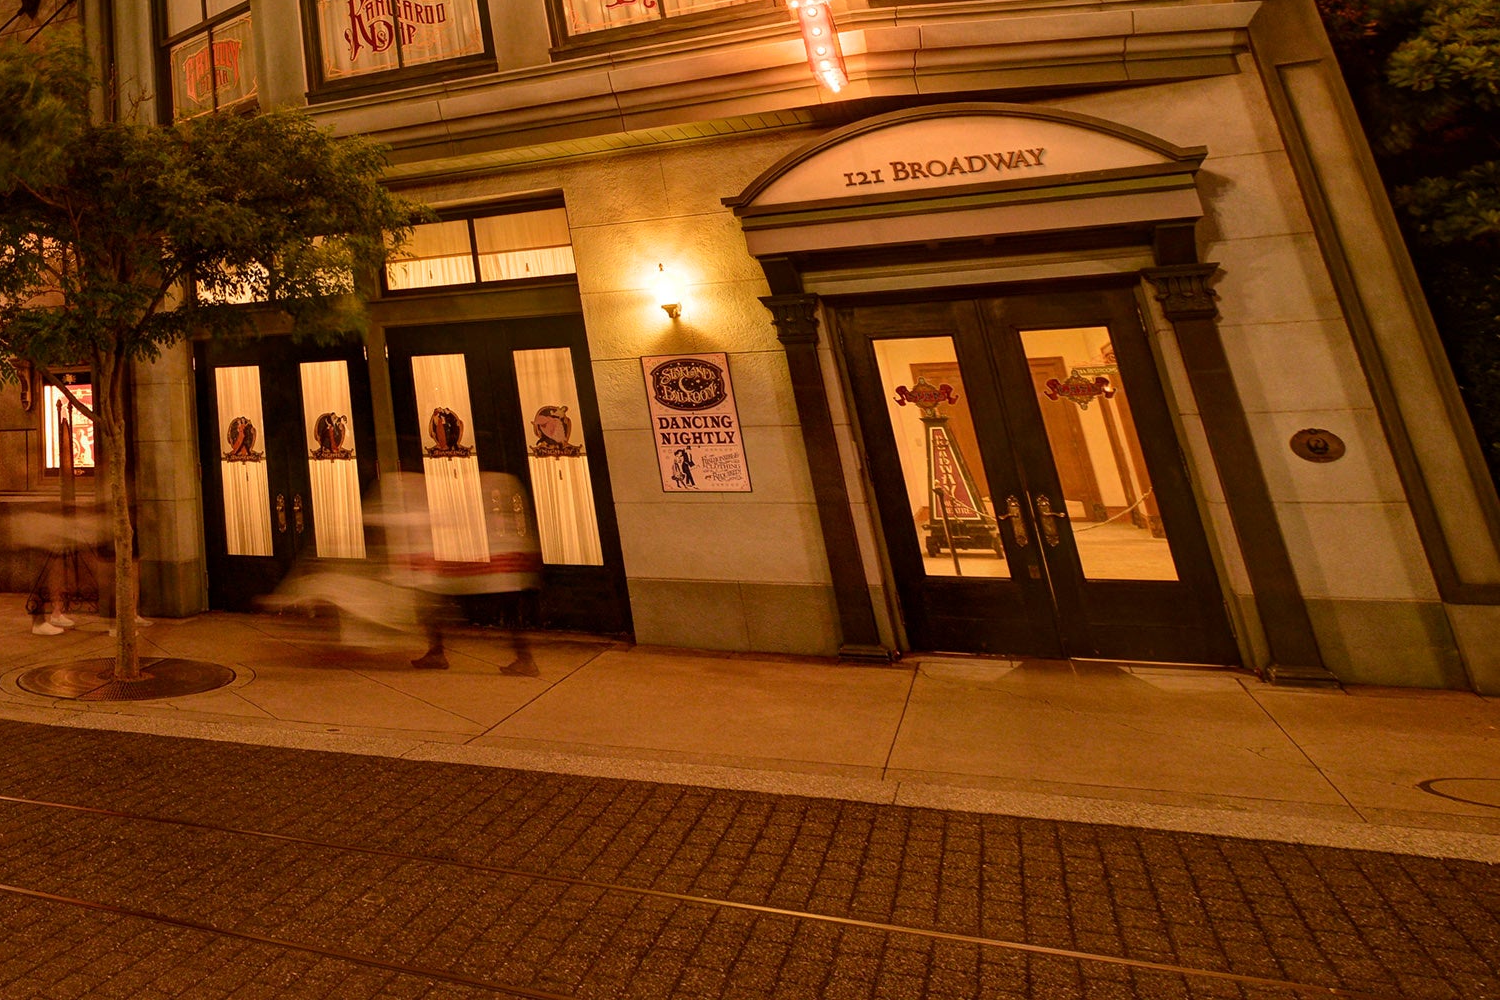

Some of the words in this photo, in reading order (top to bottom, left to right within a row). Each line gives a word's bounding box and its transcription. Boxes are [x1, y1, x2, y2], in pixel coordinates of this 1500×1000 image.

[369, 20, 416, 52] DIP
[843, 169, 884, 187] 121
[889, 148, 1044, 182] BROADWAY
[660, 366, 716, 385] STARLAND
[660, 381, 717, 404] BALLROOM
[658, 415, 732, 430] DANCING
[660, 431, 735, 445] NIGHTLY
